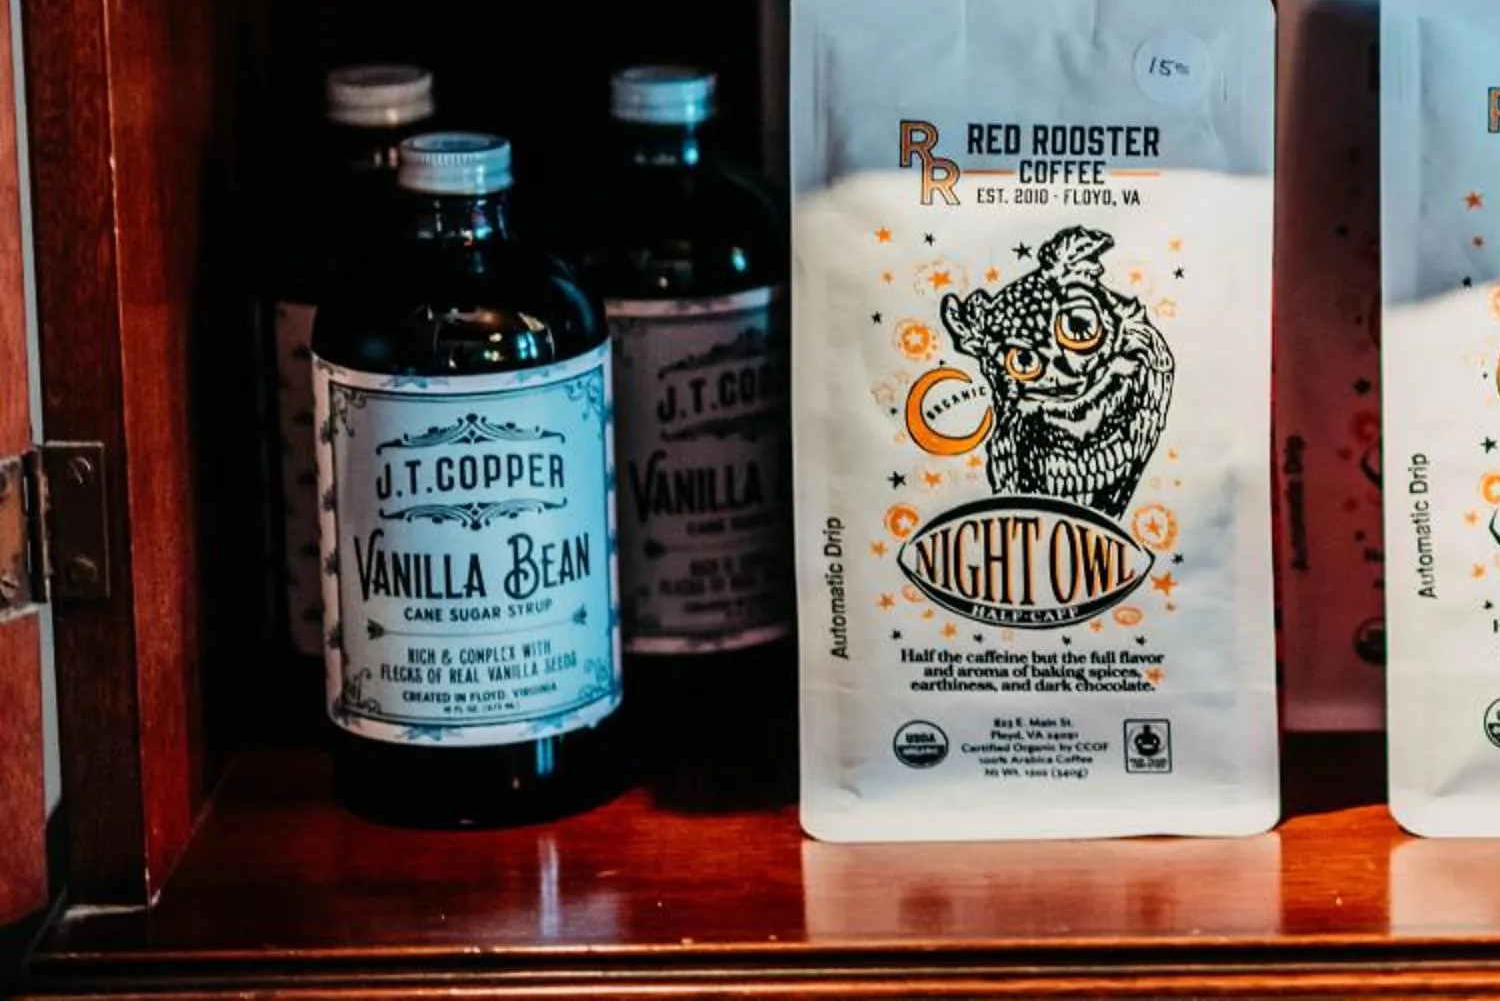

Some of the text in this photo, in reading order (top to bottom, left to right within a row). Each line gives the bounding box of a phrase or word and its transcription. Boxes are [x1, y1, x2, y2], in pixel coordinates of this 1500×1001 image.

[967, 123, 1160, 157] RED ROOSTER
[1019, 159, 1106, 185] COFFEE
[977, 188, 1141, 207] EST. 2010 FLOYD, VA
[1409, 453, 1438, 599] Automatic Drip
[353, 529, 487, 601] VANILLA
[503, 531, 591, 600] BEAN
[914, 516, 1135, 606] NIGHT OWL
[823, 516, 850, 660] Automatic Drip
[403, 599, 553, 622] CANE SUGAR SYRUP
[407, 646, 436, 665] RICH
[459, 645, 516, 665] COMPLEX
[523, 640, 551, 659] WITH
[901, 649, 1165, 664] Half the caffeine but the full flavor
[380, 651, 577, 685] FLECKS OF REAL VANILLA SEEDS
[923, 665, 954, 678] and
[957, 667, 1009, 678] aroma
[1012, 665, 1029, 678] of
[1030, 665, 1085, 682] baking
[402, 690, 451, 703] CREATED
[454, 691, 466, 703] IN
[512, 682, 557, 698] VIRGINIA
[1001, 679, 1031, 692] and
[1034, 679, 1072, 691] dark
